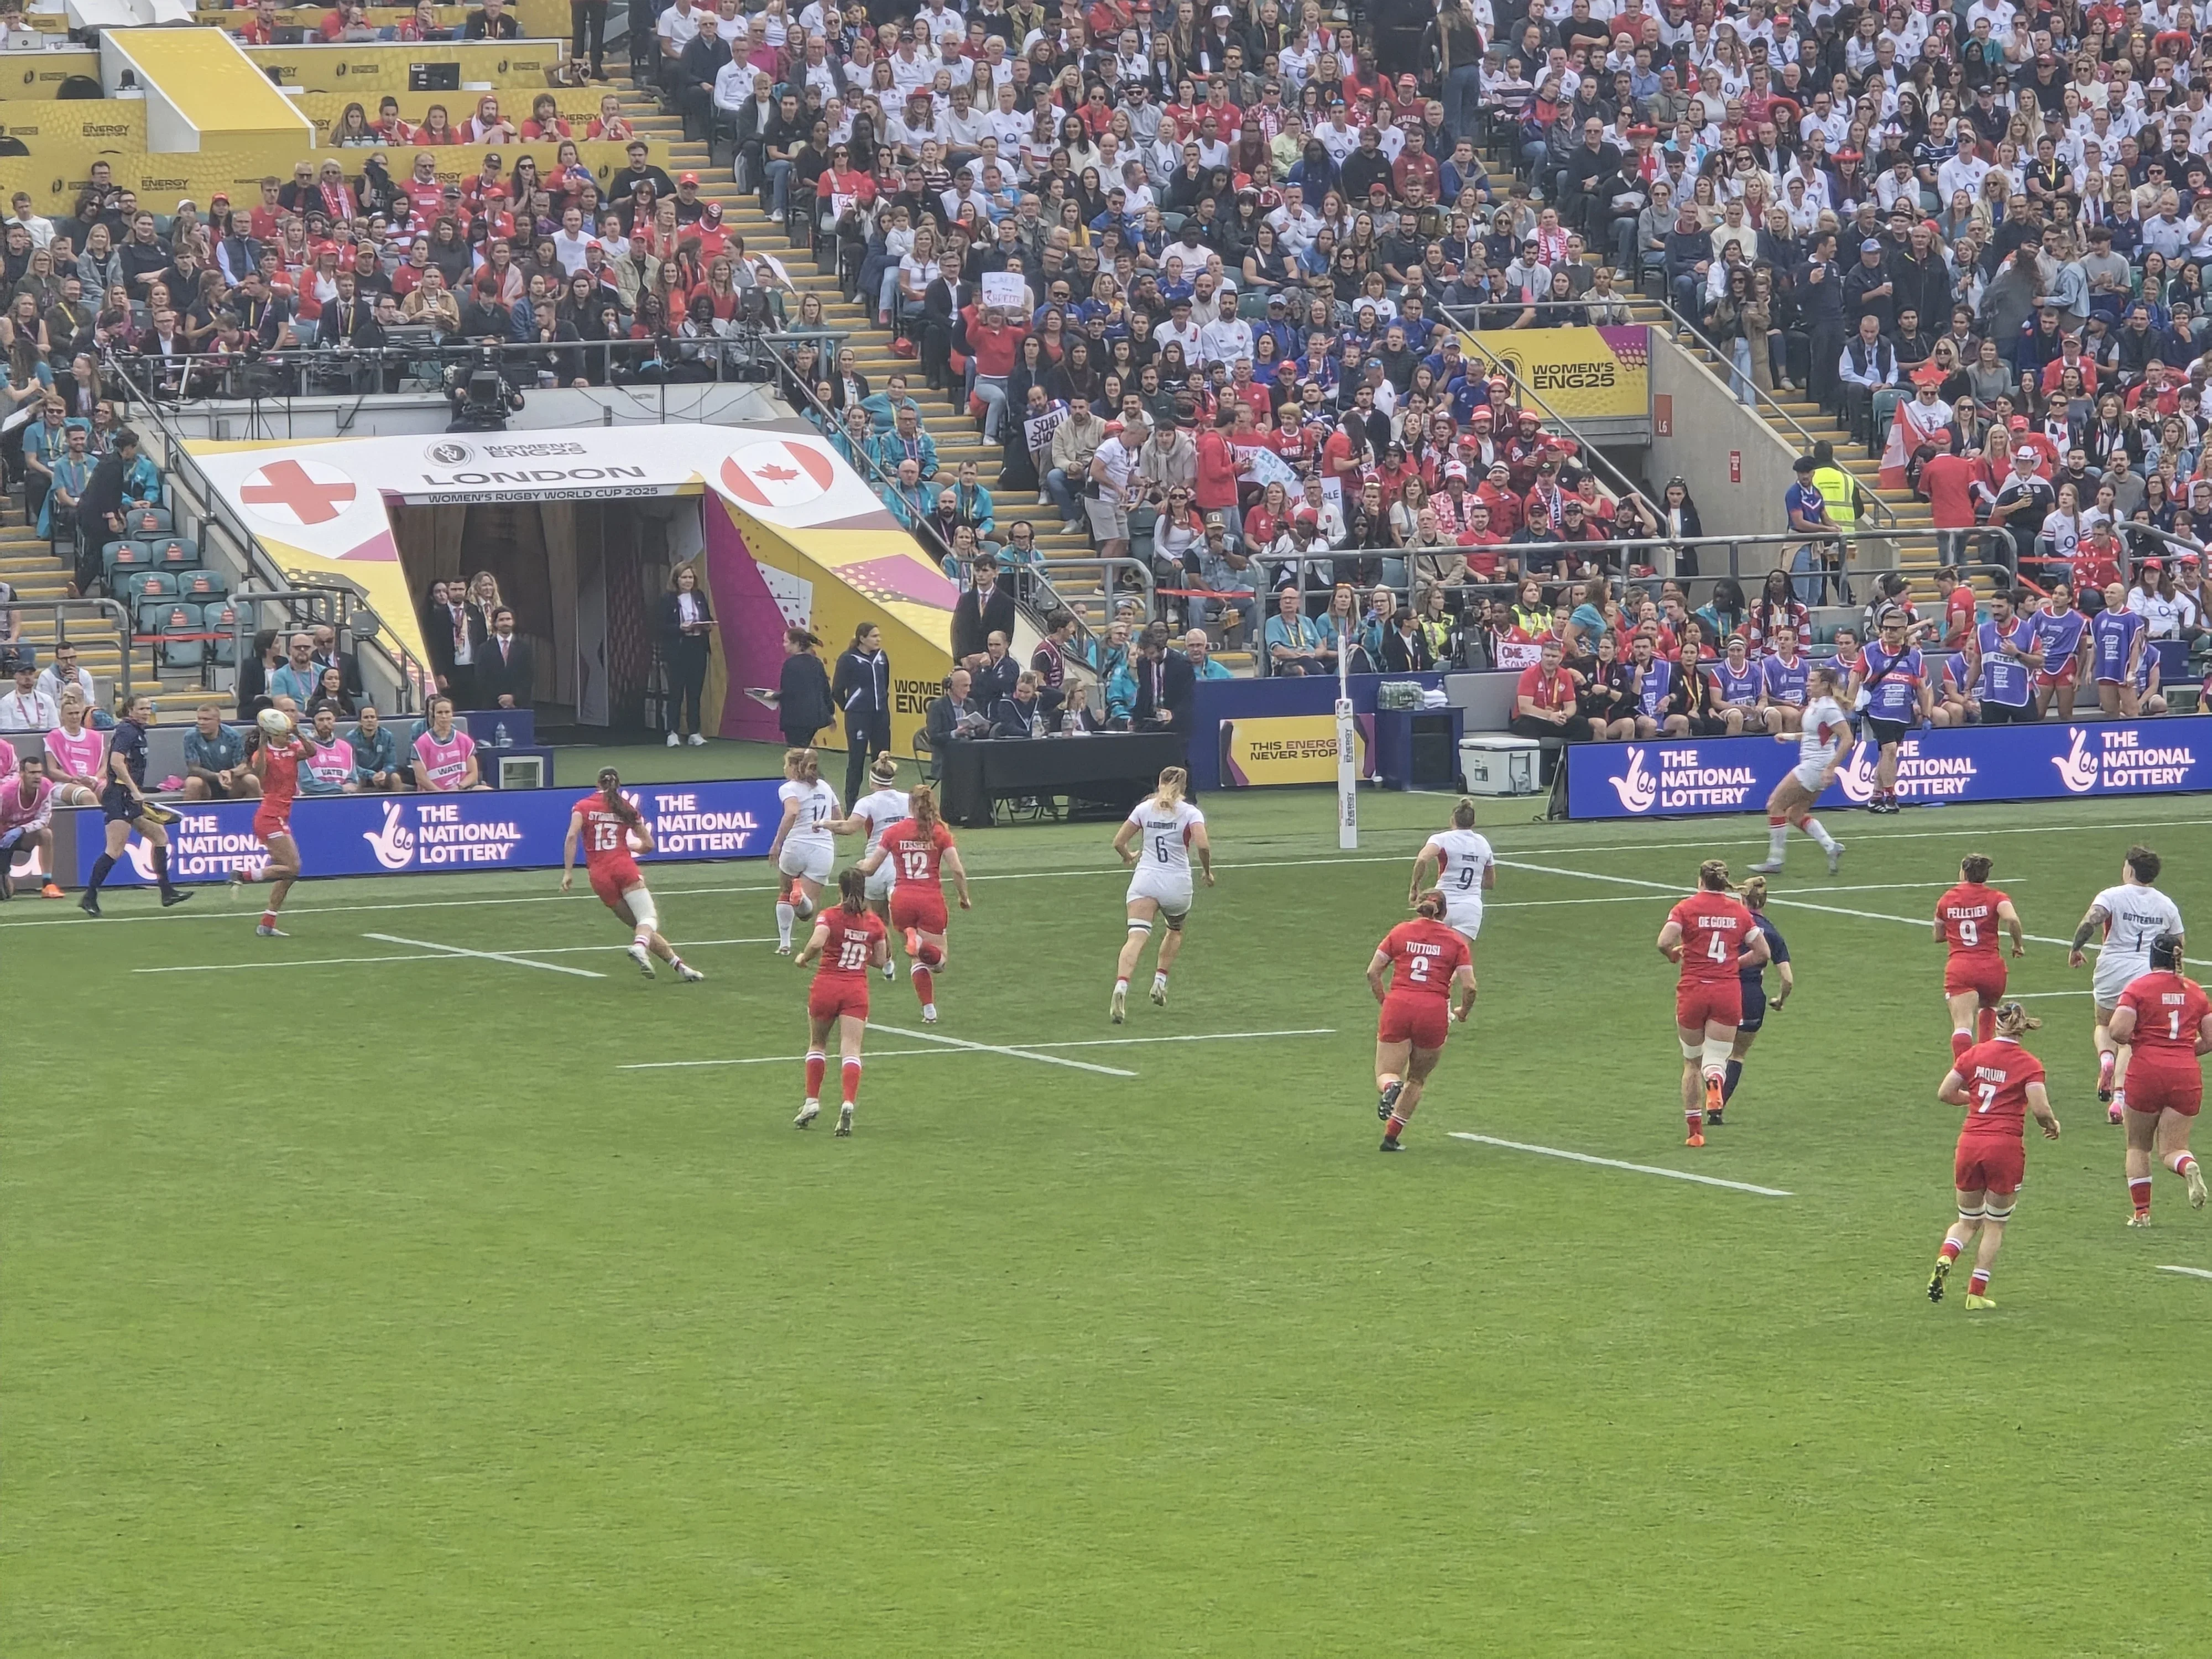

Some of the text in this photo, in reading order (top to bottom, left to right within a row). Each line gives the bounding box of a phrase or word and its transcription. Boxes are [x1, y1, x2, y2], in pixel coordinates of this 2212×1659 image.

[1532, 362, 1615, 375] WOMEN'S
[1533, 373, 1615, 390] ENG25
[483, 442, 582, 451] WOMEN'S
[488, 447, 587, 458] ENG25
[421, 466, 646, 486] LONDON
[429, 487, 658, 503] WOMEN'S RUGBY WORLD CUP 2025
[1250, 739, 1337, 751] THIS ENERG
[1896, 740, 1920, 758] HE
[2101, 731, 2138, 748] THE
[1250, 749, 1338, 761] NEVER STOP
[1659, 750, 1698, 768] THE
[2103, 748, 2196, 768] NATIONAL
[1661, 767, 1756, 787] NATIONAL
[1897, 758, 1977, 777] ATIONAL
[2104, 768, 2187, 787] LOTTERY
[1894, 777, 1968, 796] OTTERY
[655, 794, 696, 812] THE
[1662, 787, 1746, 807] LOTTERY
[417, 805, 458, 823] THE
[657, 812, 757, 832] NATIONAL
[180, 816, 217, 834] THE
[419, 822, 521, 843] NATIONAL
[178, 834, 268, 854] NATIONA
[594, 823, 618, 851] 13
[658, 832, 747, 853] LOTTERY
[420, 843, 510, 864] LOTTERY
[1155, 836, 1168, 863] 6
[178, 854, 270, 875] LOTTERY
[902, 852, 930, 879] 12
[1456, 867, 1474, 890] 9
[1698, 916, 1710, 927] DE
[1947, 905, 1988, 919] PELLETIER
[1959, 920, 1978, 947] 9
[2135, 930, 2143, 952] 1
[838, 941, 867, 970] 10
[1406, 941, 1441, 956] TUTTOSI
[1707, 931, 1727, 963] 4
[1410, 956, 1429, 982] 2
[2168, 1010, 2179, 1040] 1
[1974, 1066, 2006, 1083] PAQUIN
[1978, 1083, 1996, 1113] 7
